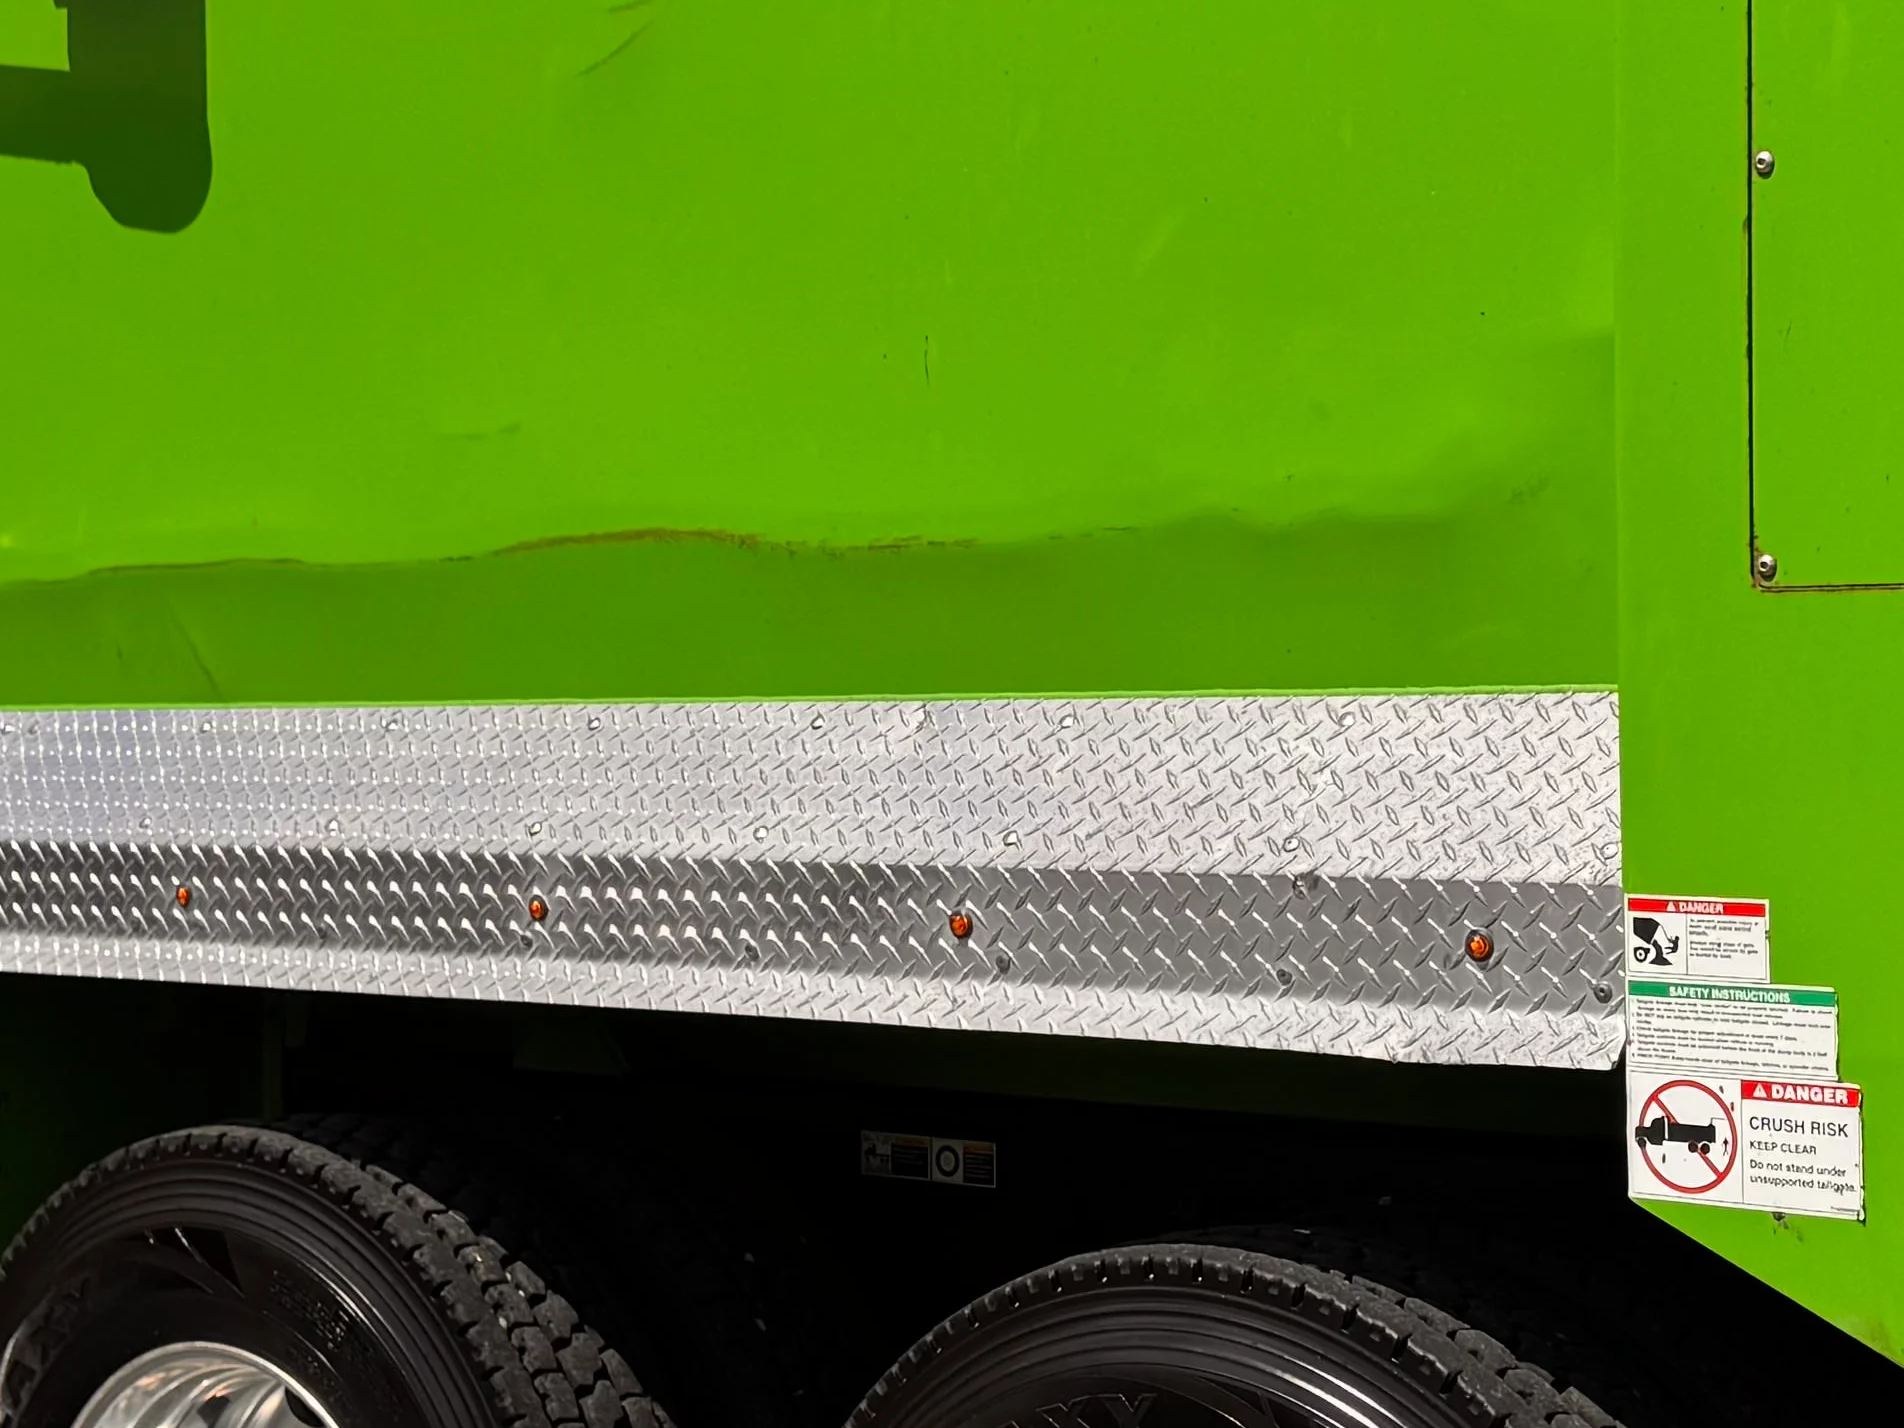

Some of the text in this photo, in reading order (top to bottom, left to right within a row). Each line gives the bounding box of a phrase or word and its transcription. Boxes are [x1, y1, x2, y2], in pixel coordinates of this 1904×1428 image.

[1679, 901, 1724, 915] DANGER
[1669, 986, 1791, 1003] SAFETY INSTRUCTIONS
[1771, 1082, 1848, 1105] DANGER
[1749, 1116, 1849, 1138] CRUSH RISK
[1749, 1140, 1817, 1155] KEEP CLEAR
[1749, 1159, 1847, 1177] Do not stand under
[1750, 1175, 1815, 1188] unsupported
